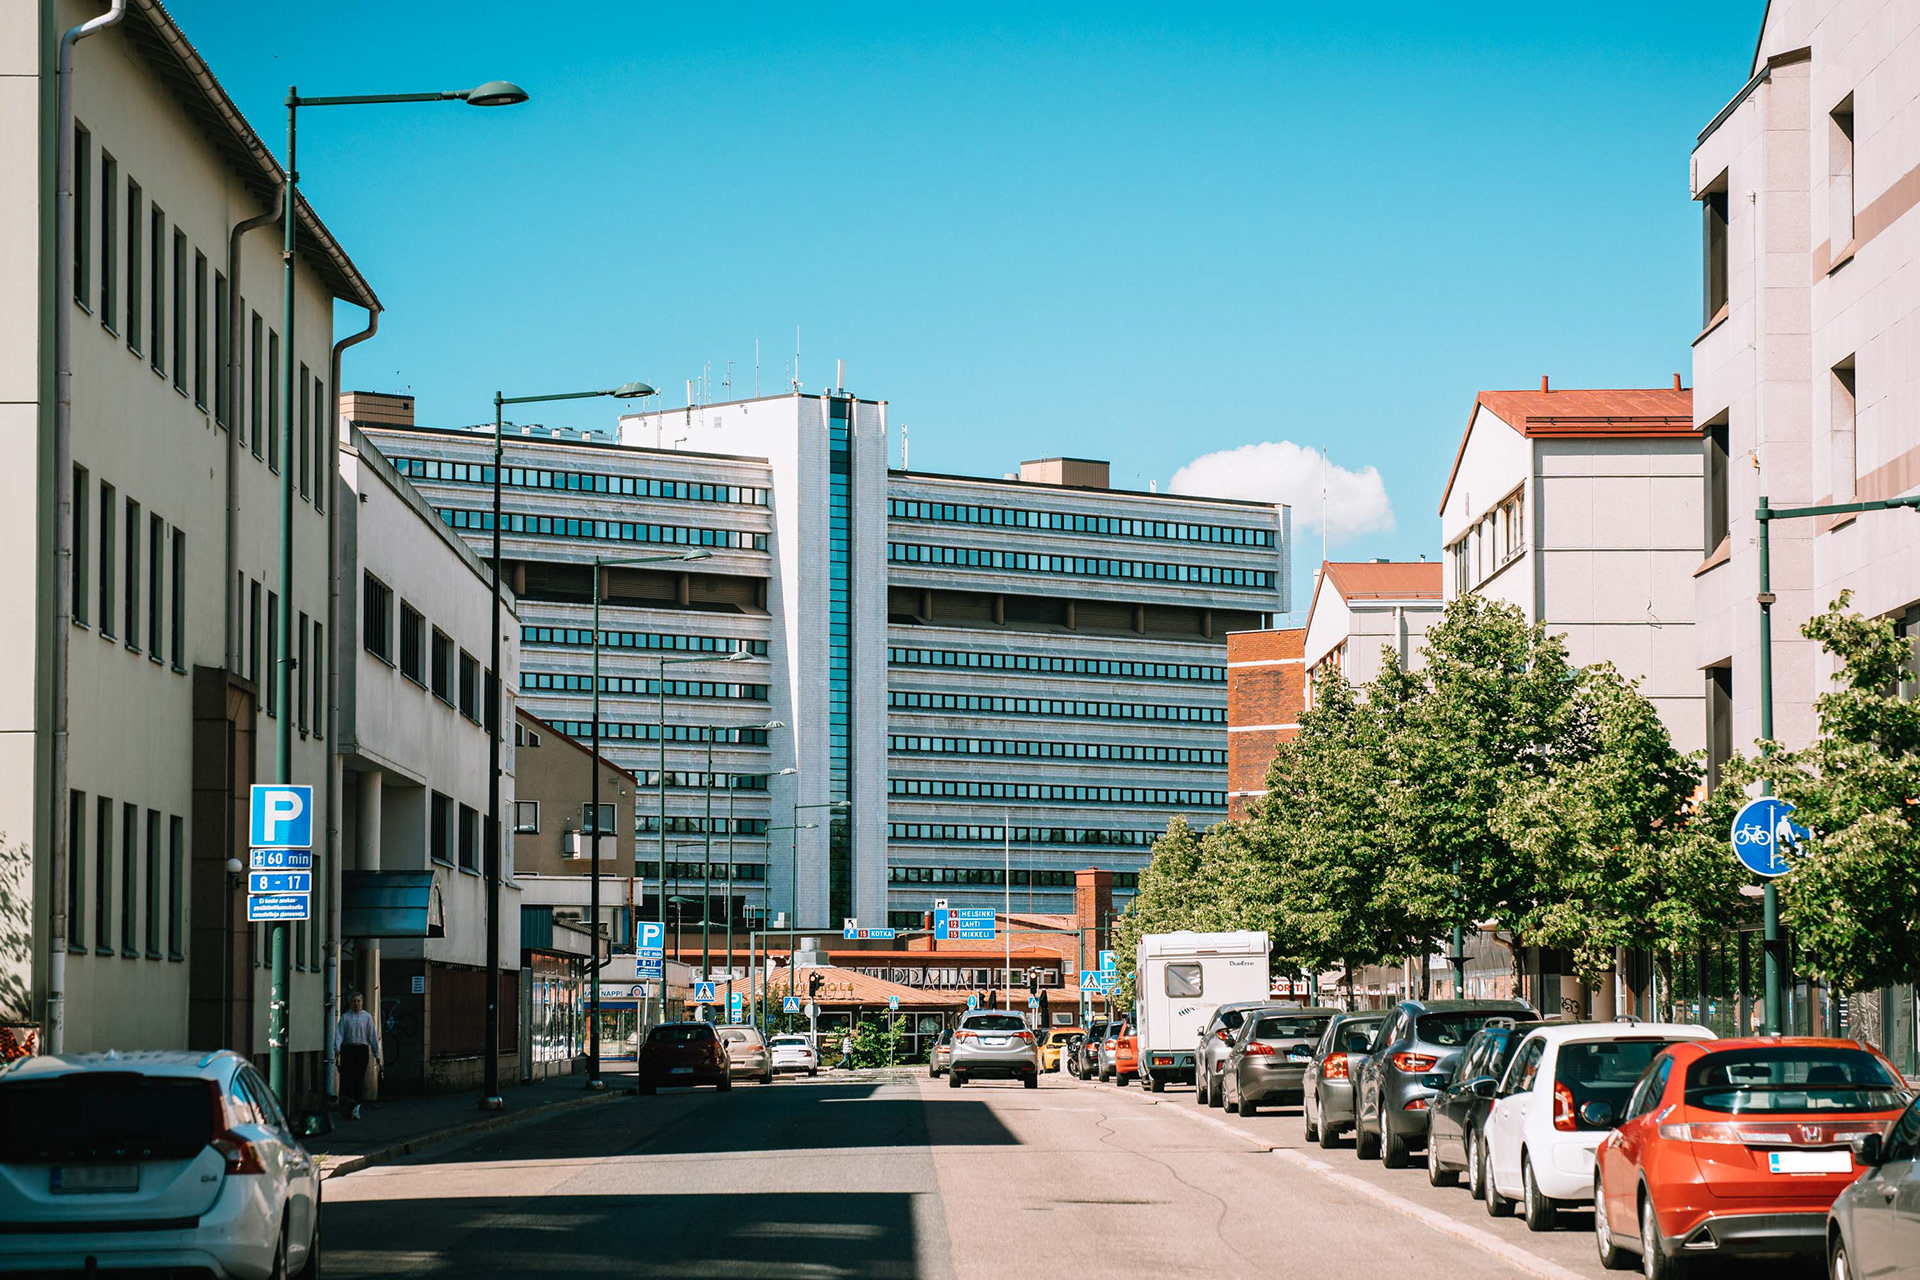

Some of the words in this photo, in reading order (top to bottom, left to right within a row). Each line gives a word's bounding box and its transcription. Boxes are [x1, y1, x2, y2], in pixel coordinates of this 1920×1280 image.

[264, 791, 303, 841] P
[268, 853, 283, 865] 60
[288, 854, 309, 865] min
[259, 876, 268, 890] 8
[288, 876, 301, 890] 17
[950, 920, 957, 928] 12
[643, 924, 660, 946] P
[1104, 952, 1116, 969] P
[1271, 983, 1303, 992] PORTI
